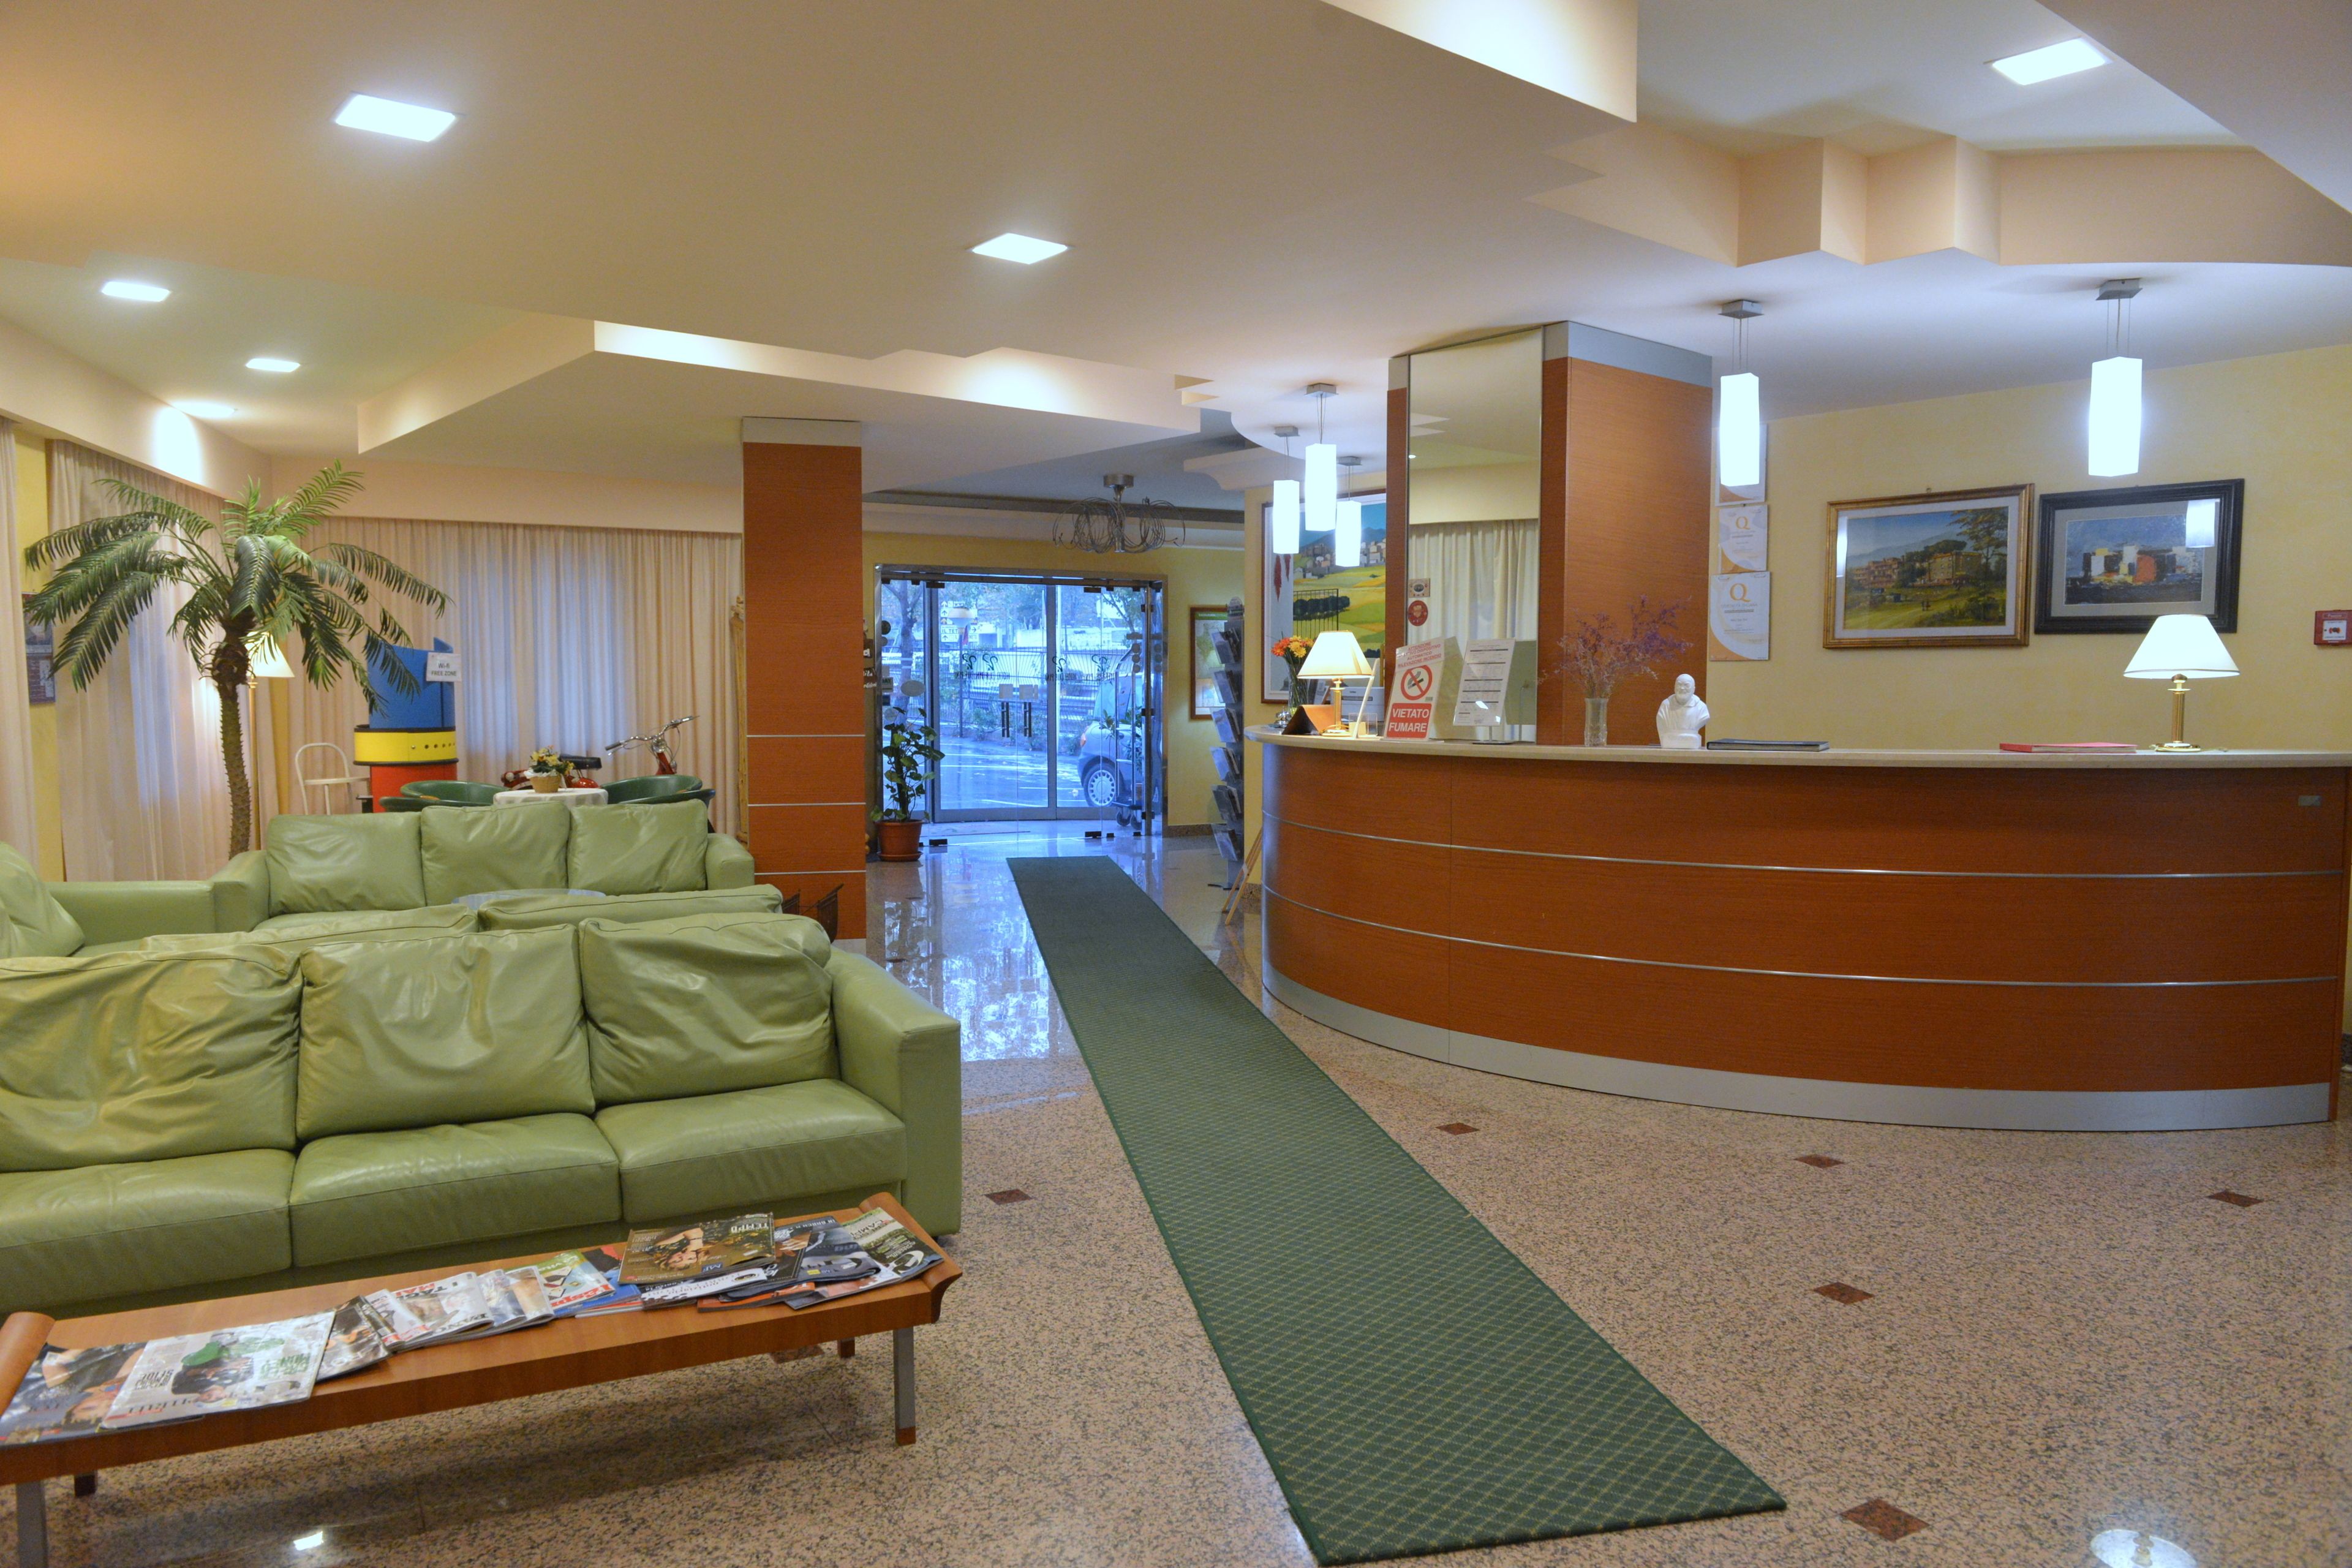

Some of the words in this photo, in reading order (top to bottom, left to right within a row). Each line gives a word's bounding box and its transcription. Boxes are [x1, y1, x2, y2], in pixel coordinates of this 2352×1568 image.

[1730, 582, 1751, 603] Q
[1407, 651, 1432, 661] AUTOMATICO
[1392, 709, 1430, 718] VIETATO
[1388, 722, 1428, 733] FUMARE
